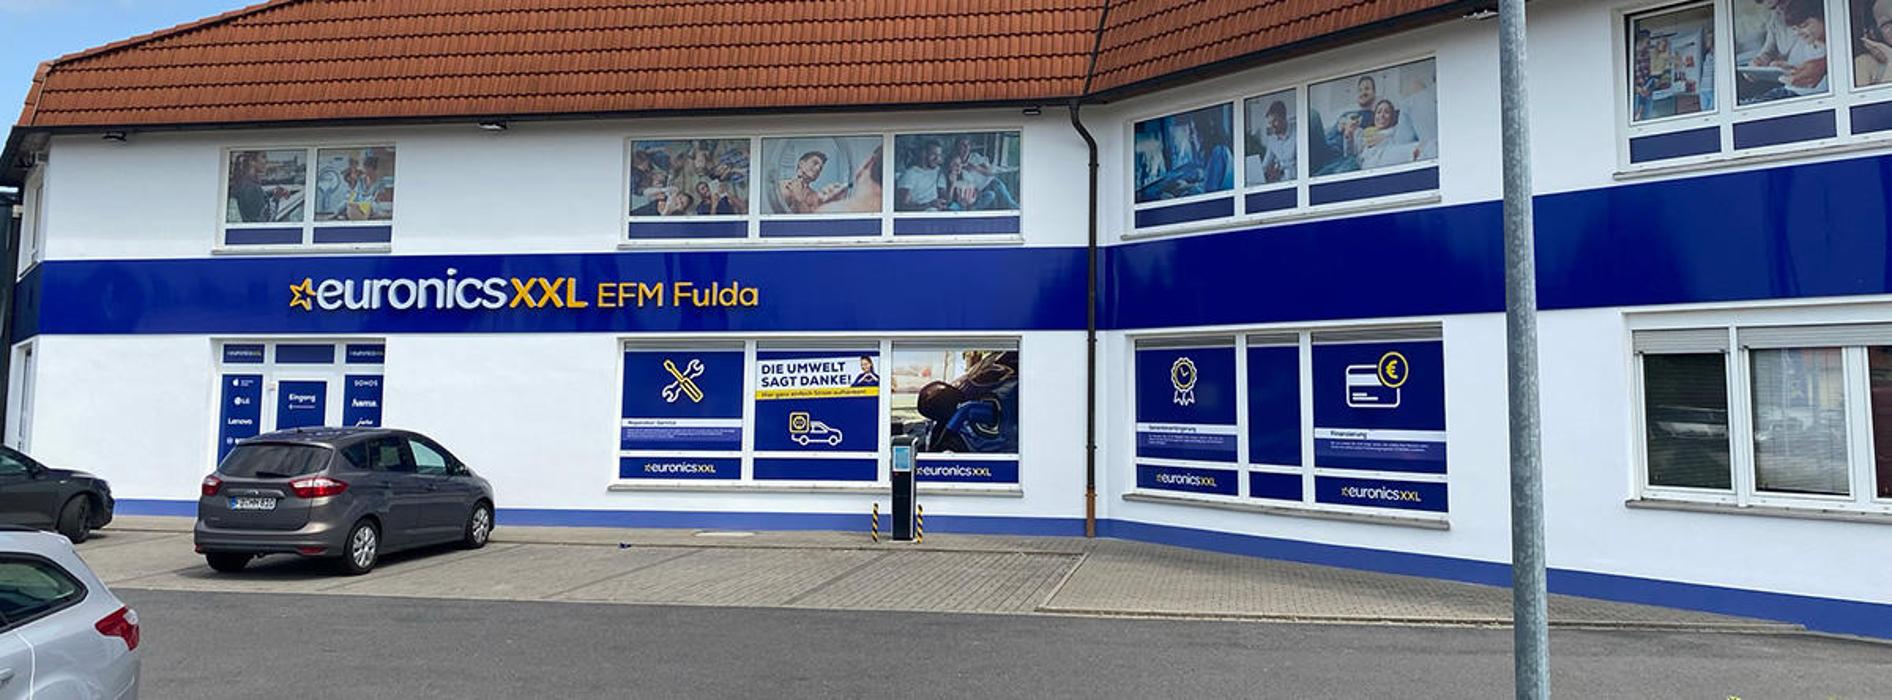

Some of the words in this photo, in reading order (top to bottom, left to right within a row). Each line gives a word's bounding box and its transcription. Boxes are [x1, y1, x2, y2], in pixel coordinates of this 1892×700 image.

[597, 282, 664, 307] EFM
[673, 281, 759, 307] Fulda
[761, 364, 784, 374] DIE
[787, 362, 846, 374] UMWELT
[761, 376, 797, 388] SAGT
[800, 374, 851, 386] DANKE!
[289, 393, 316, 403] Eingang
